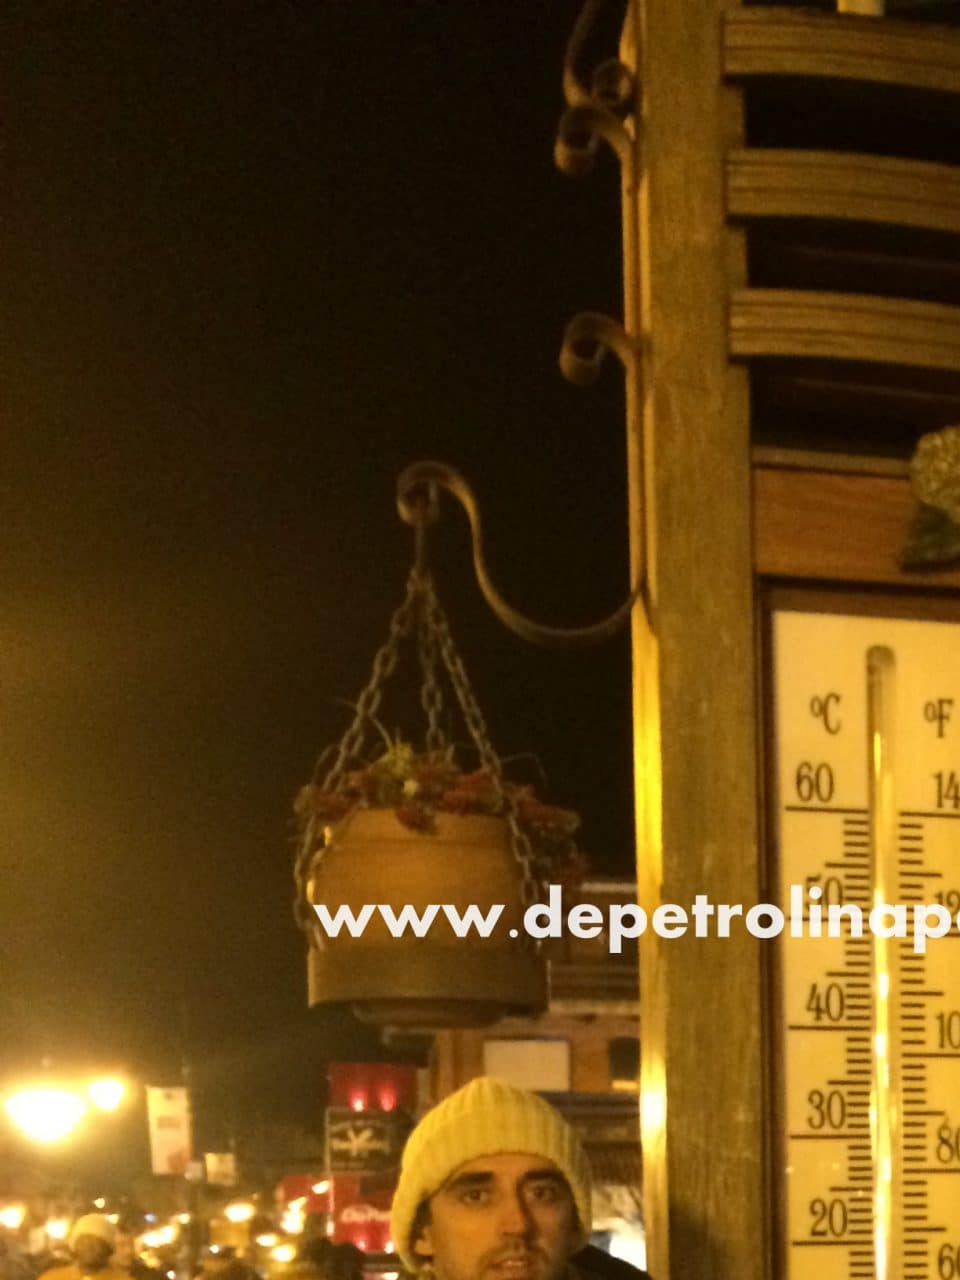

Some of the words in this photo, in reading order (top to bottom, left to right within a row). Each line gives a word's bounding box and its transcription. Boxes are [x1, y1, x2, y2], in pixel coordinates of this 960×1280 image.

[795, 762, 834, 802] 60
[806, 982, 845, 1022] 40
[807, 1089, 847, 1130] 30
[809, 1198, 849, 1237] 20
